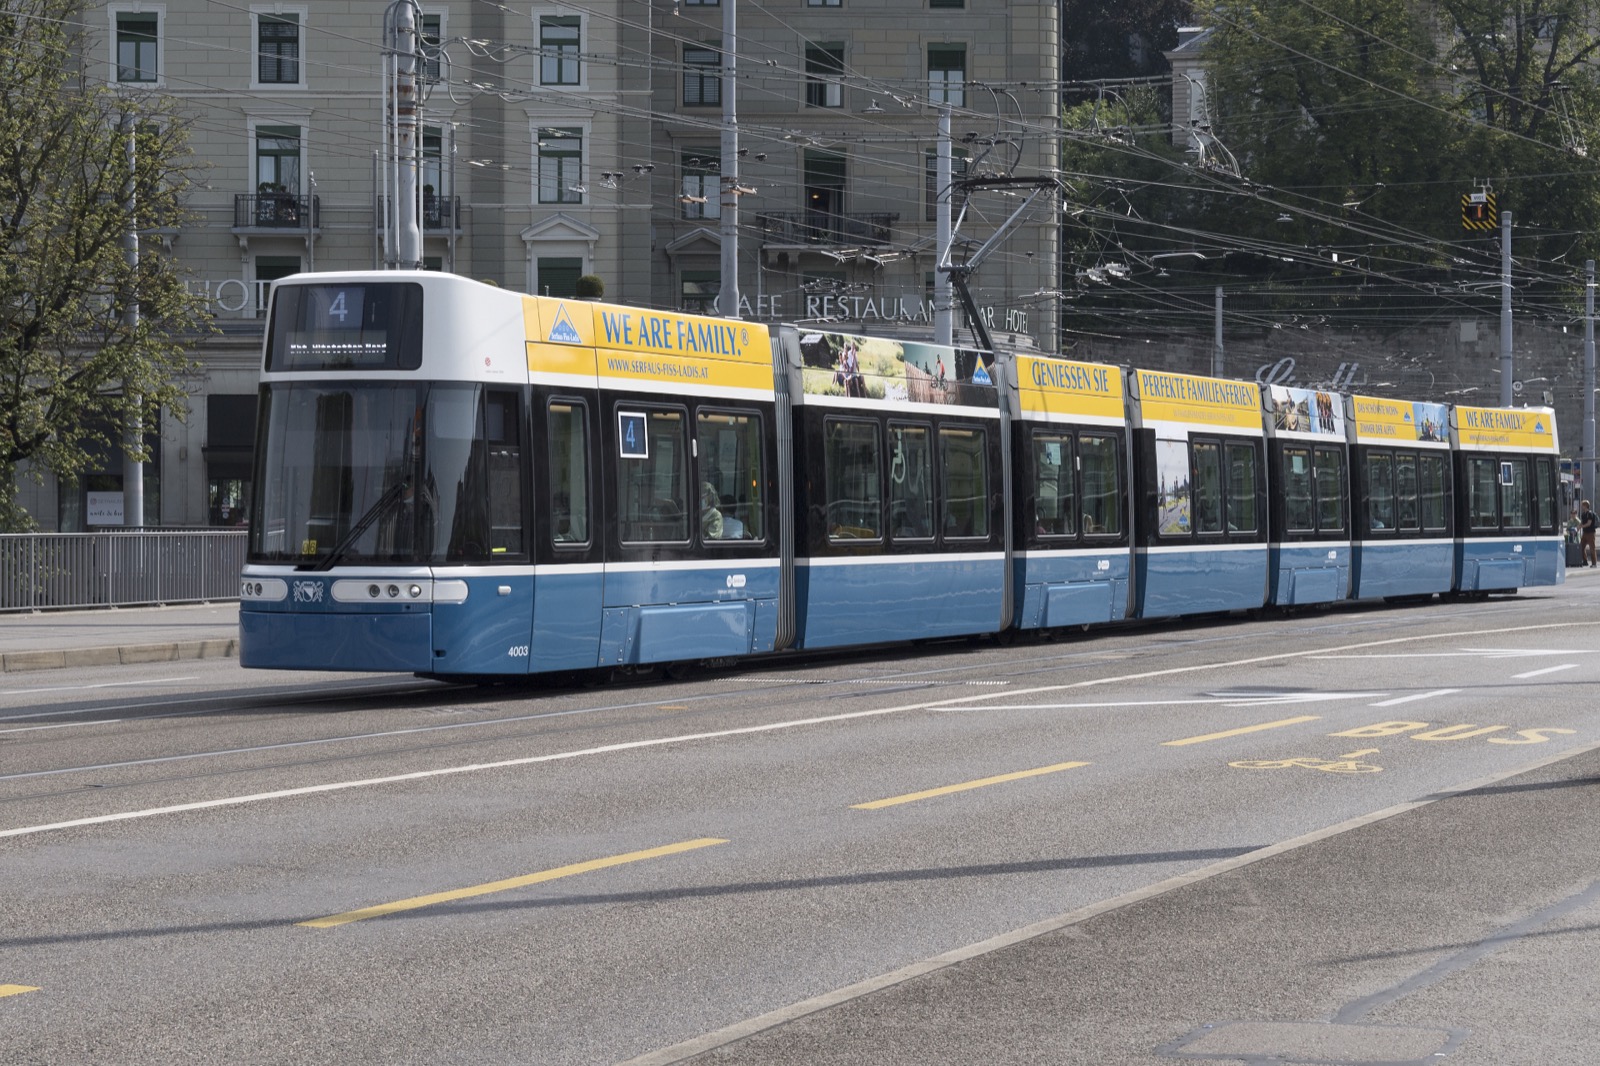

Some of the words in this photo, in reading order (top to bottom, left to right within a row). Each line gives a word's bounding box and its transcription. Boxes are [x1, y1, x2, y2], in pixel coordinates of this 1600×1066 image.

[329, 291, 348, 322] 4
[601, 311, 632, 345] WE
[638, 315, 673, 349] ARE
[1005, 308, 1029, 334] HOTEL
[607, 358, 709, 379] WWW.SERFAUS-FISS-LADIS.AT
[1032, 361, 1092, 391] GENIESSEN
[1093, 368, 1109, 392] SIE
[1142, 374, 1186, 400] PERFEKTE
[1187, 379, 1256, 407] FAMILIENFERIEN!
[626, 419, 636, 448] 4
[1466, 411, 1479, 428] WE
[1480, 411, 1494, 429] ARE
[508, 645, 529, 657] 4003
[1327, 720, 1577, 745] BUS
